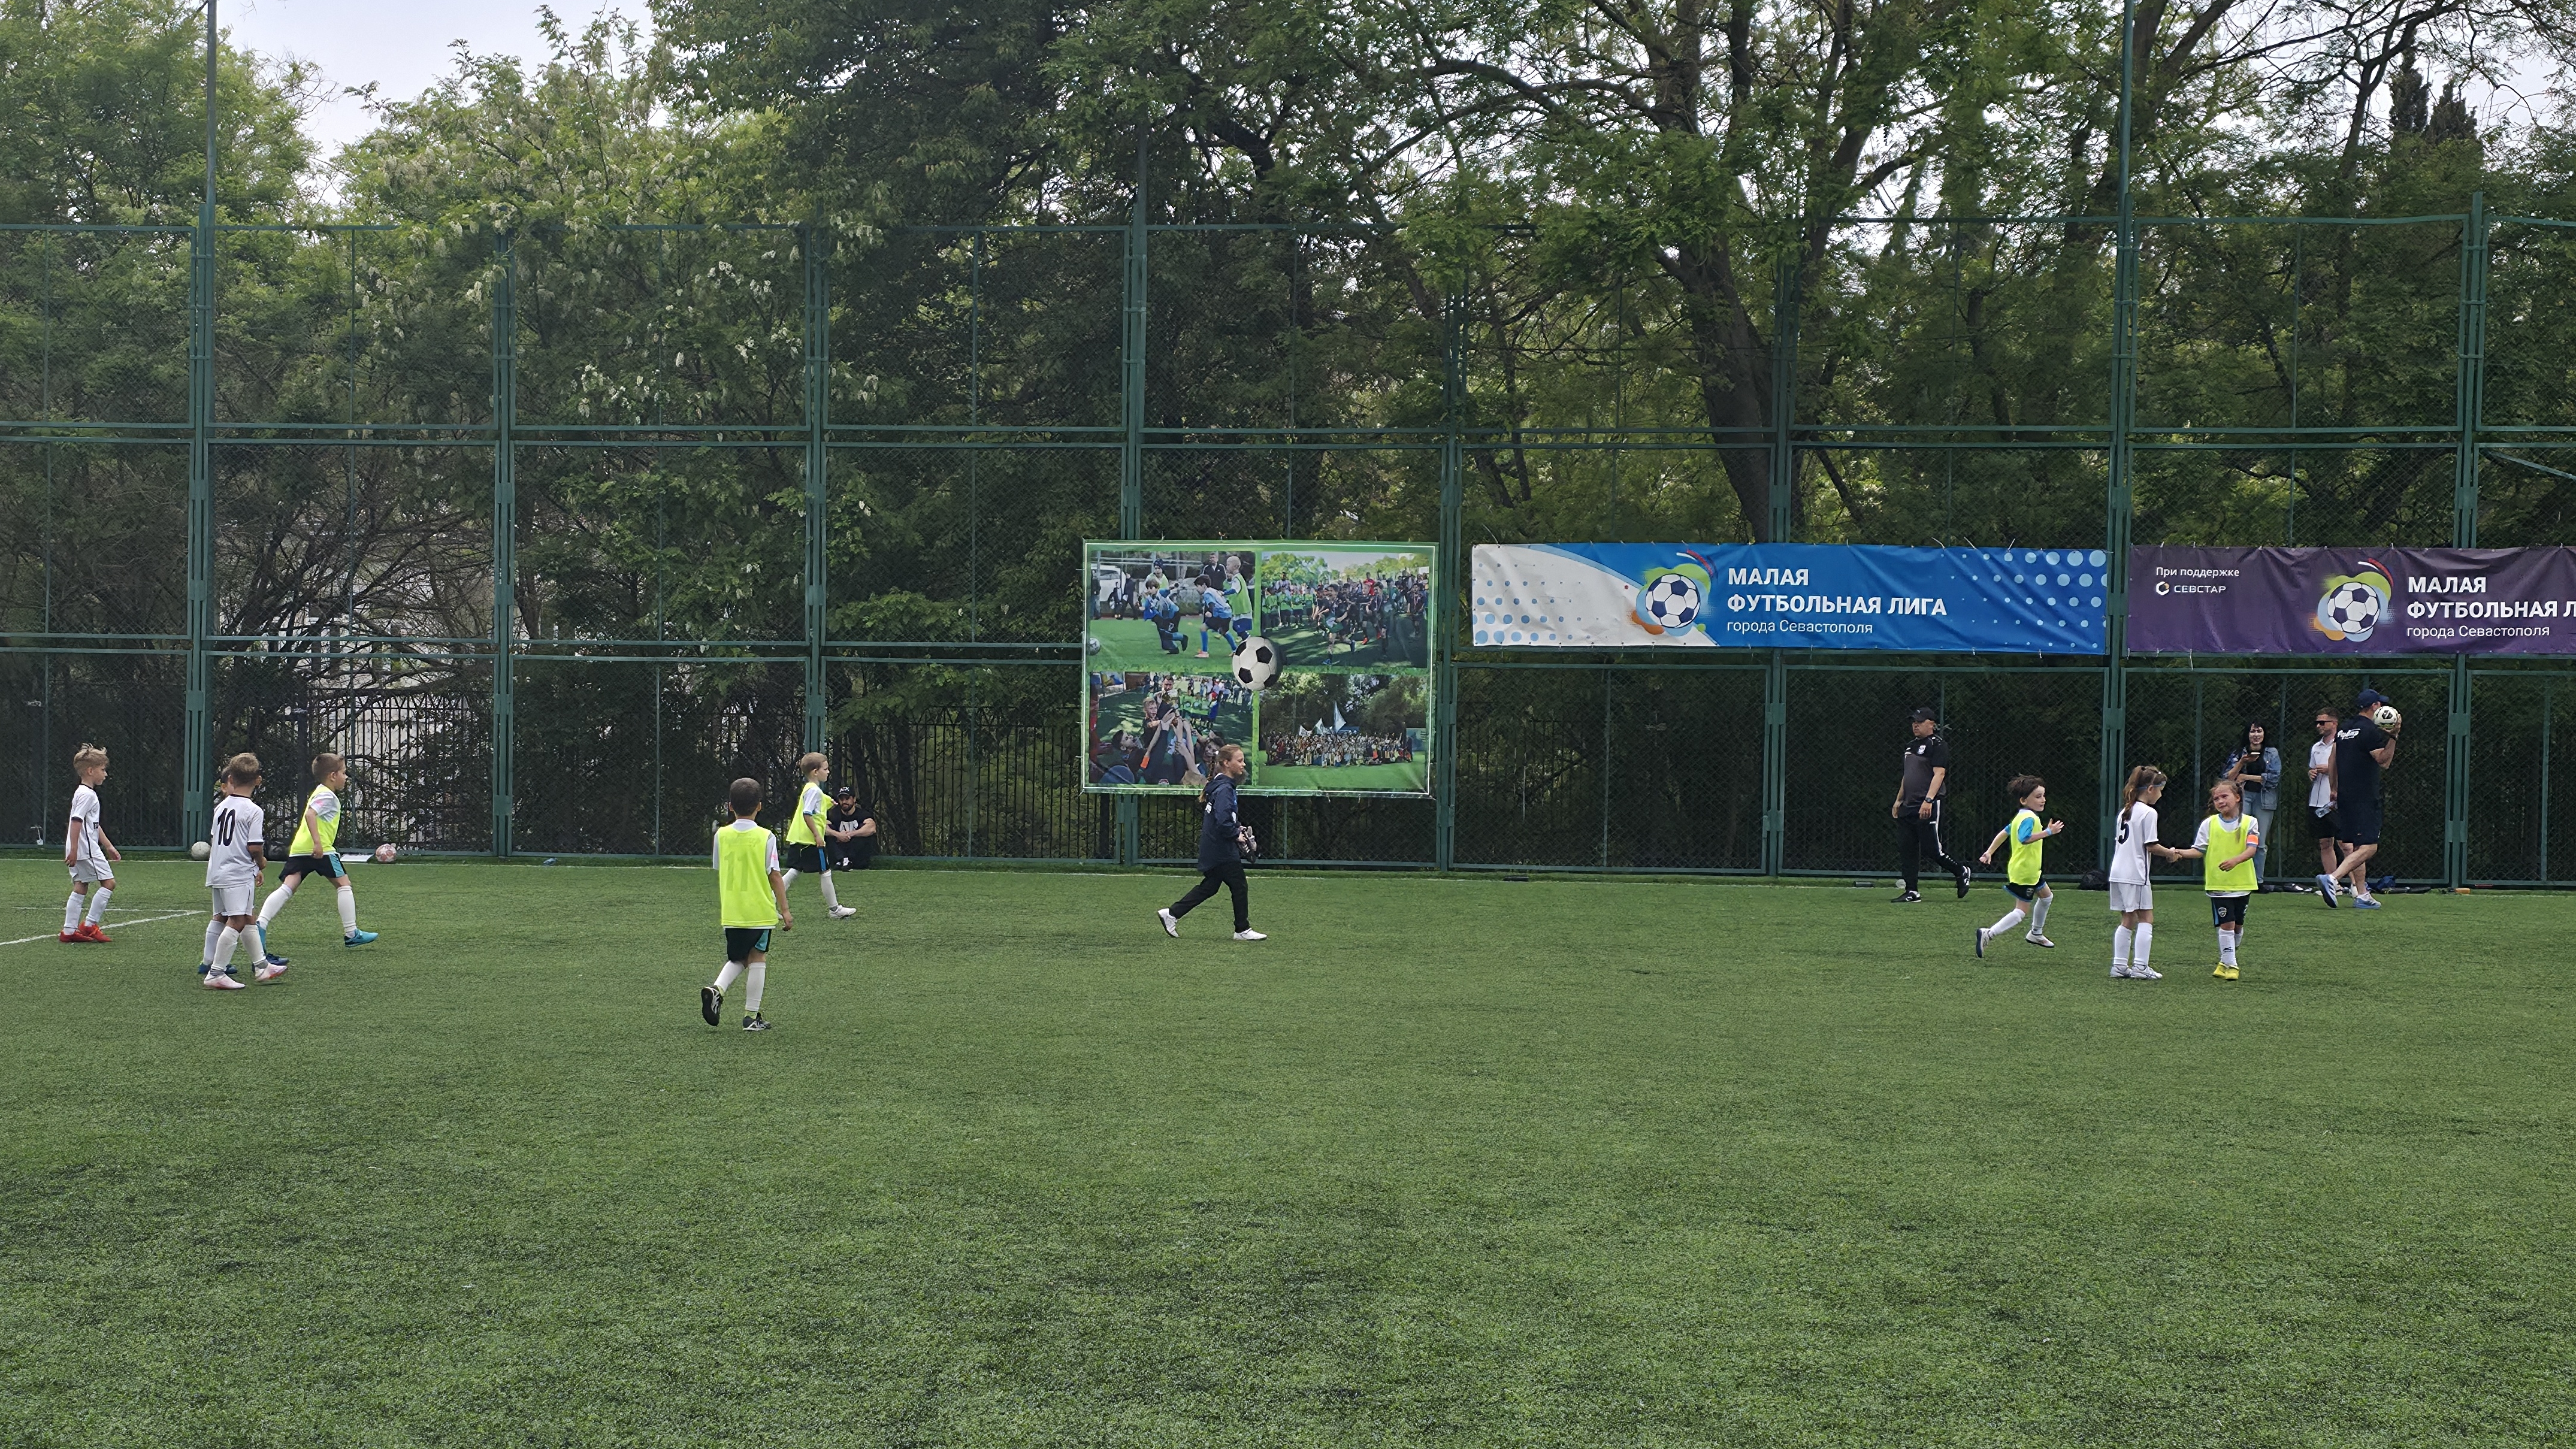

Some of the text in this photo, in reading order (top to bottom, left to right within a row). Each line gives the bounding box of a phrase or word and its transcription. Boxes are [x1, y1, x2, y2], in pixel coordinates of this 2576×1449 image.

[1728, 568, 1809, 586] МАЛАЯ
[2156, 567, 2240, 578] При поддержке
[2408, 577, 2486, 593] МАЛАЯ
[1727, 594, 1947, 616] ФУТБОЛЬНАЯ ЛИГА
[2407, 601, 2557, 618] ФУТБОЛЬНАЯ
[1727, 619, 1873, 634] города Севастополя
[2407, 625, 2549, 639] города Севастополя
[217, 807, 235, 846] 10
[2118, 821, 2129, 845] 5
[724, 851, 748, 891] 11
